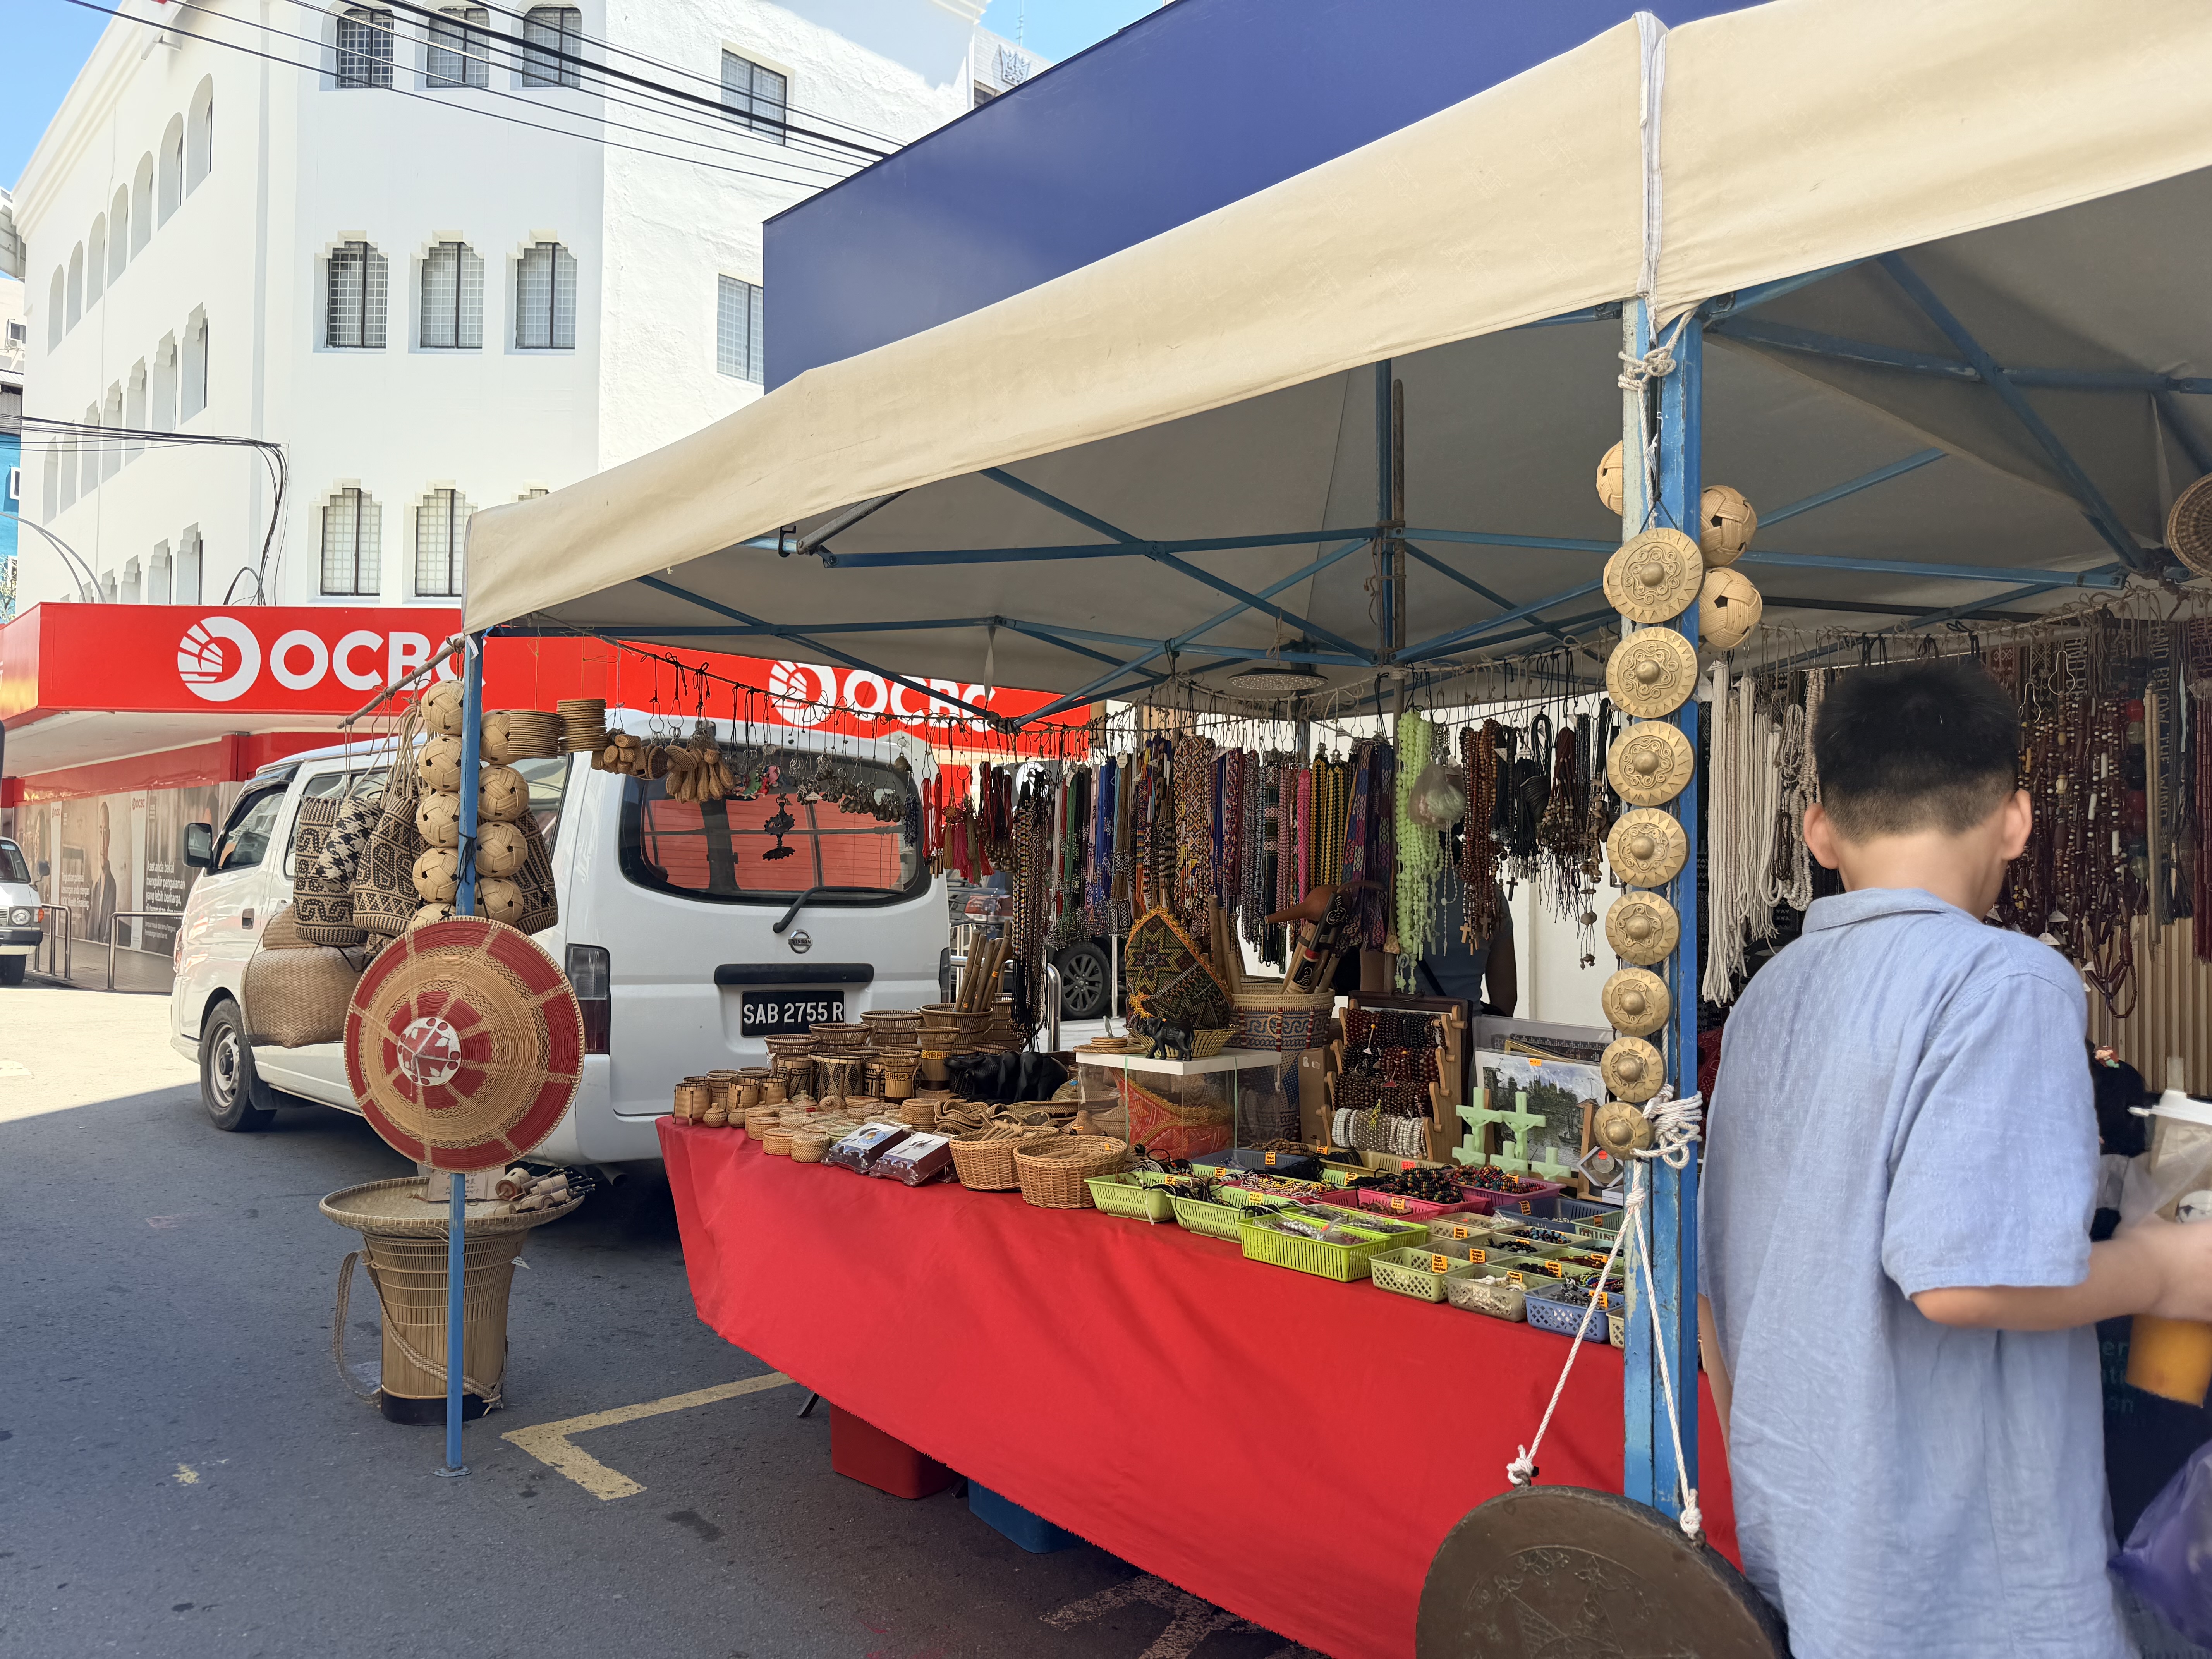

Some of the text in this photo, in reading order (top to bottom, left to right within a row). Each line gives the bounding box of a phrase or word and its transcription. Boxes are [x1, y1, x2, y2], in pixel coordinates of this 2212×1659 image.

[843, 670, 996, 732] OCBC
[155, 861, 164, 872] anda
[164, 861, 174, 874] bakal
[146, 876, 185, 891] mengukir pengalaman
[146, 891, 155, 903] yang
[155, 890, 164, 902] lebih
[744, 1002, 843, 1024] SAB 2755 R
[922, 1051, 948, 1059] SABAH
